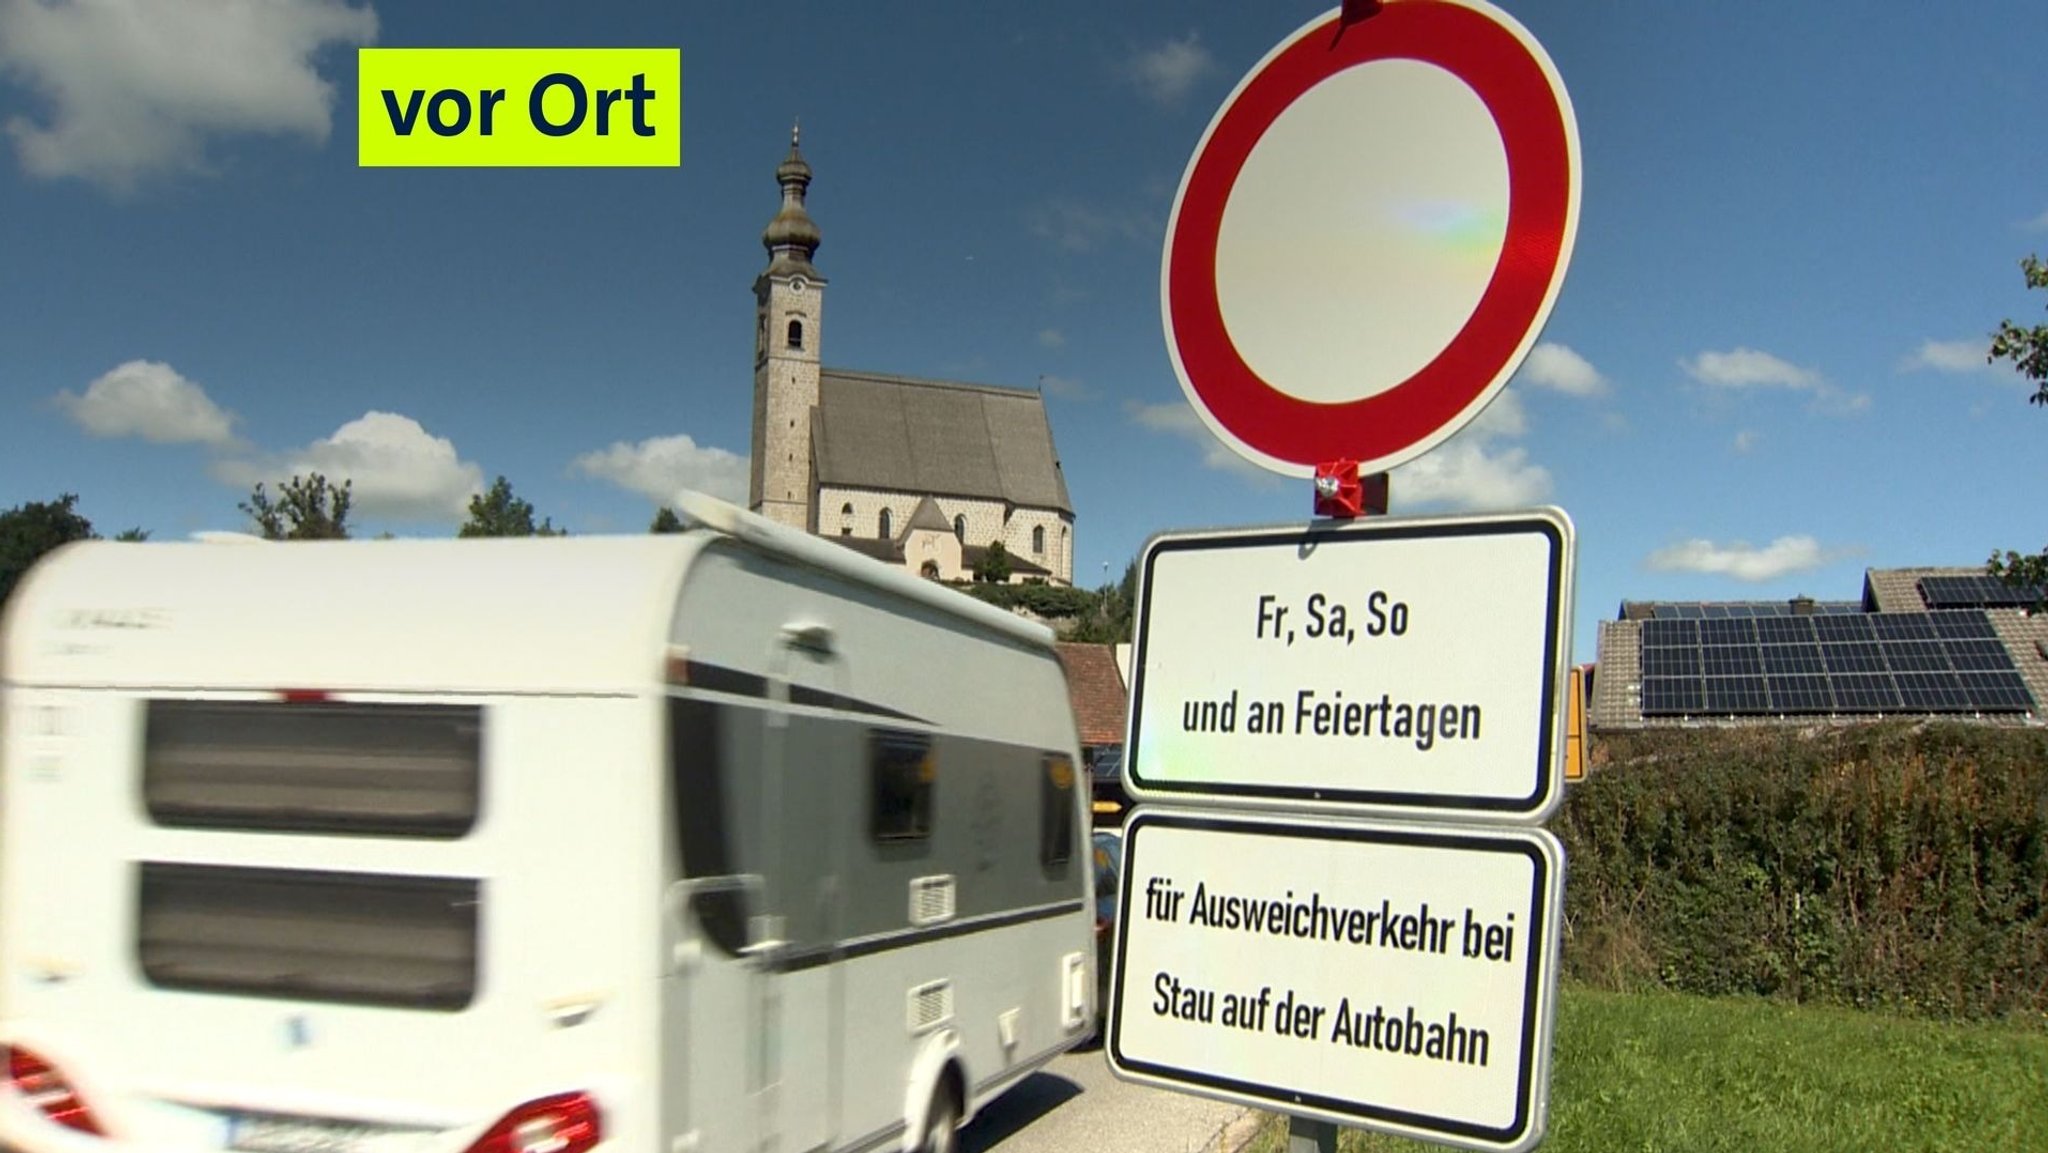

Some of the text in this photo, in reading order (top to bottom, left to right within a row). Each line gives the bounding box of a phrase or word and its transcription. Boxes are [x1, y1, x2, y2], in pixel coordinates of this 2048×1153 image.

[1257, 590, 1408, 646] Fr, Sa, So
[1183, 690, 1481, 751] und an Feiertagen
[1146, 877, 1515, 963] für Ausweichverkehr bei
[1153, 972, 1489, 1067] Stau auf der Autobahn
